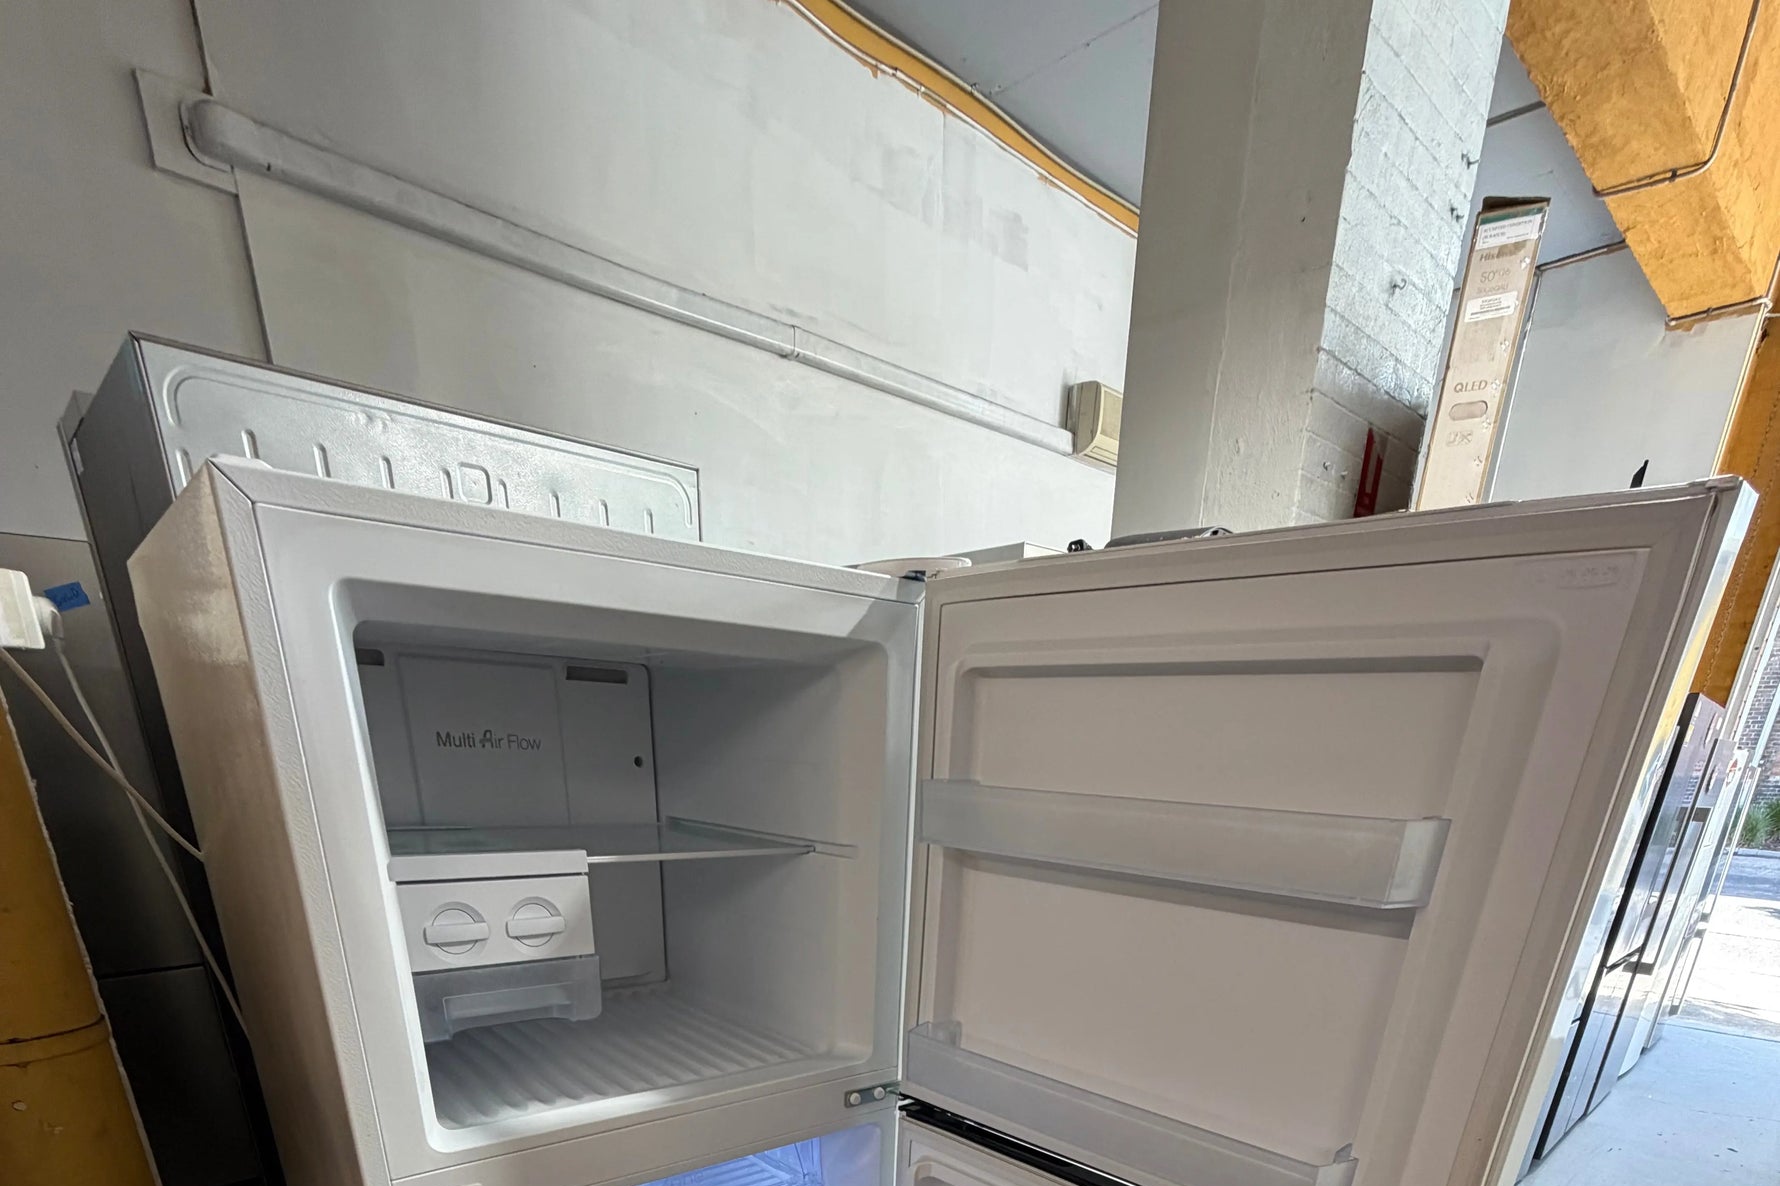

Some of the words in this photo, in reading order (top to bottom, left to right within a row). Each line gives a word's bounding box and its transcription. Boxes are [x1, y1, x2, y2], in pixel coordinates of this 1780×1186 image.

[1454, 380, 1488, 393] QLED
[436, 731, 476, 748] Multi
[479, 729, 504, 749] Air
[507, 734, 541, 750] Flow
